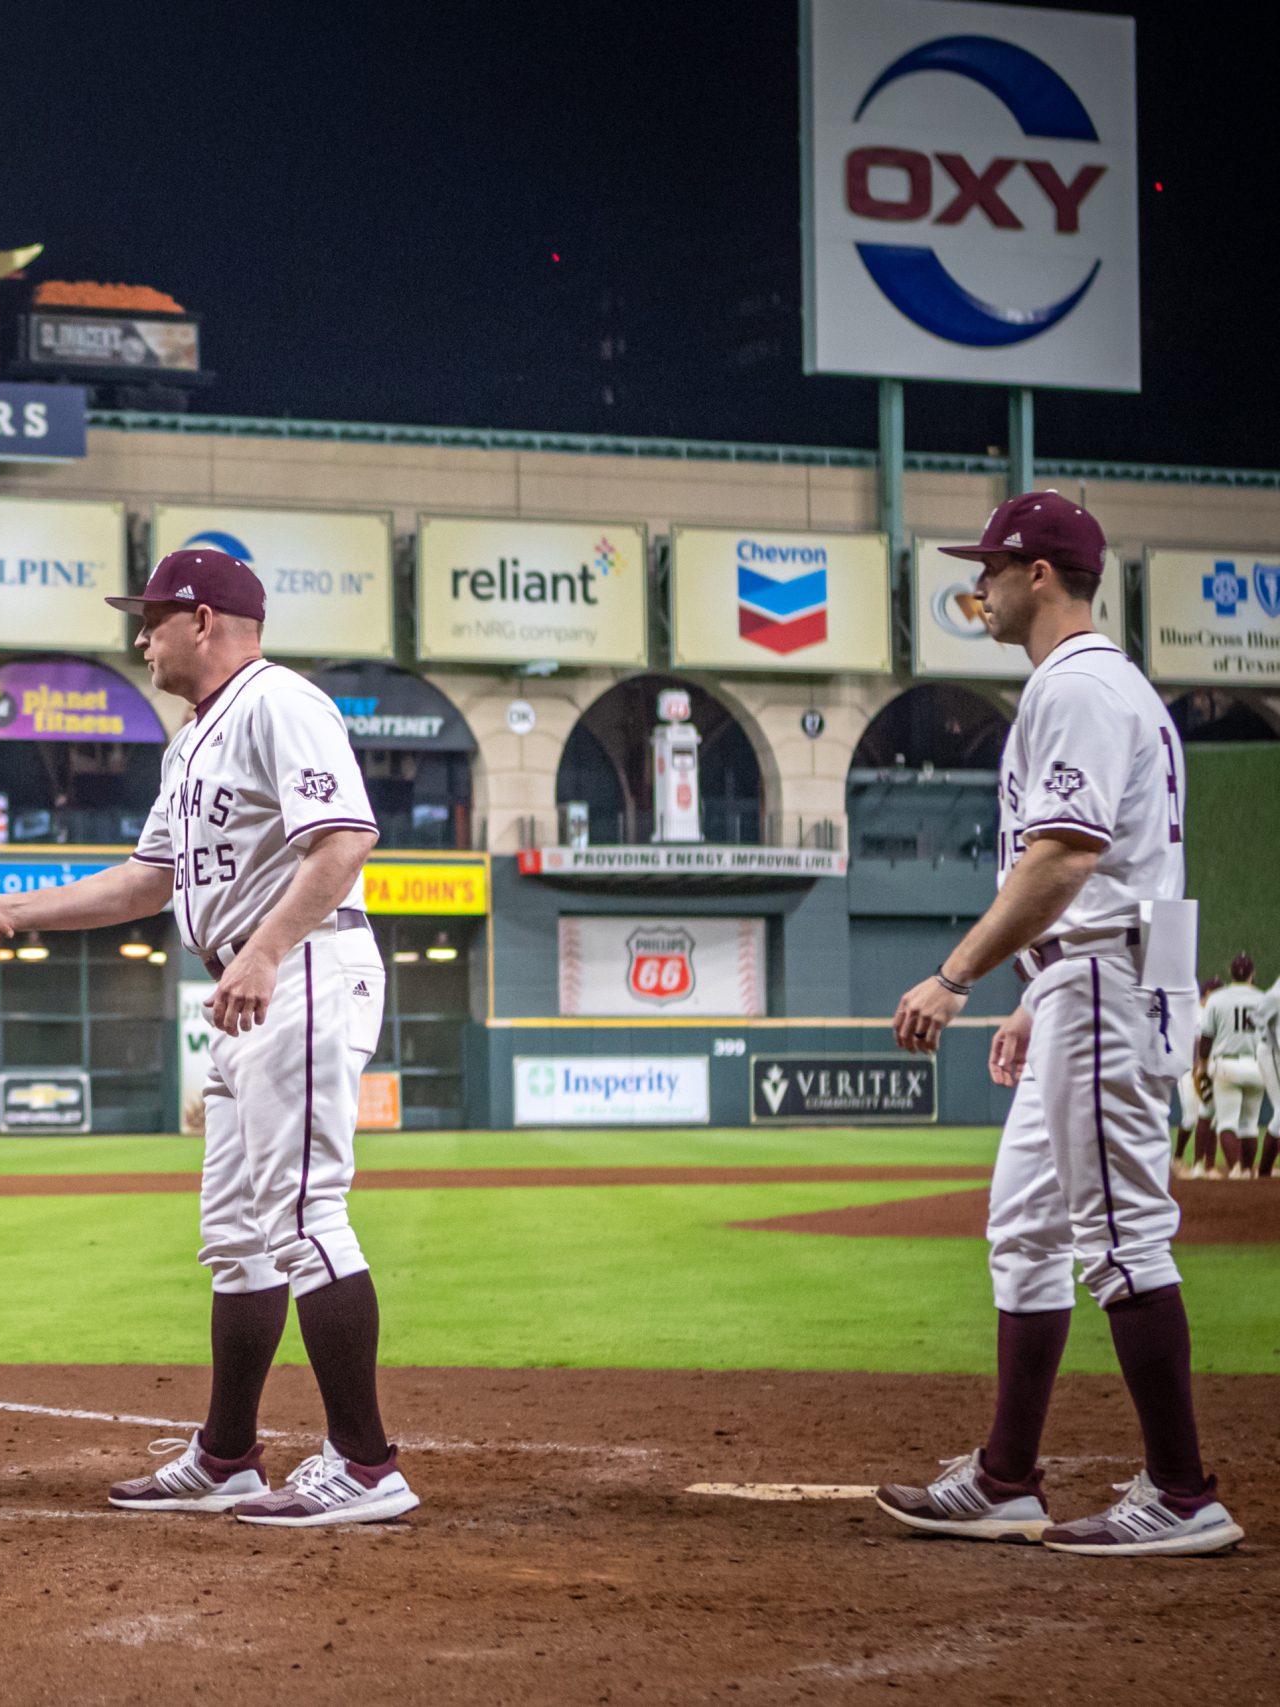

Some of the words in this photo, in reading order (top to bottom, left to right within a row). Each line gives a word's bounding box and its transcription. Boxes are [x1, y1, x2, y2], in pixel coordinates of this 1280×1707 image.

[845, 146, 1108, 234] OXY
[737, 539, 827, 565] Chevron
[275, 569, 333, 595] ZERO
[452, 559, 598, 605] reliant
[452, 622, 472, 638] an
[476, 620, 516, 640] NRG
[520, 624, 598, 648] company
[1213, 656, 1230, 673] of
[23, 684, 108, 716] planet
[34, 709, 124, 735] fitness
[345, 715, 444, 737] PORTSNET
[573, 853, 660, 867] PROVIDING
[732, 853, 802, 868] IMPROVING
[806, 857, 833, 869] LIVES
[399, 879, 475, 904] JOHN'S
[635, 937, 686, 953] PHILLIPS
[638, 958, 683, 990] 66
[713, 1040, 746, 1057] 399
[563, 1066, 679, 1101] Insperity
[796, 1069, 923, 1098] VERITEX
[805, 1097, 879, 1111] COMMUNITY
